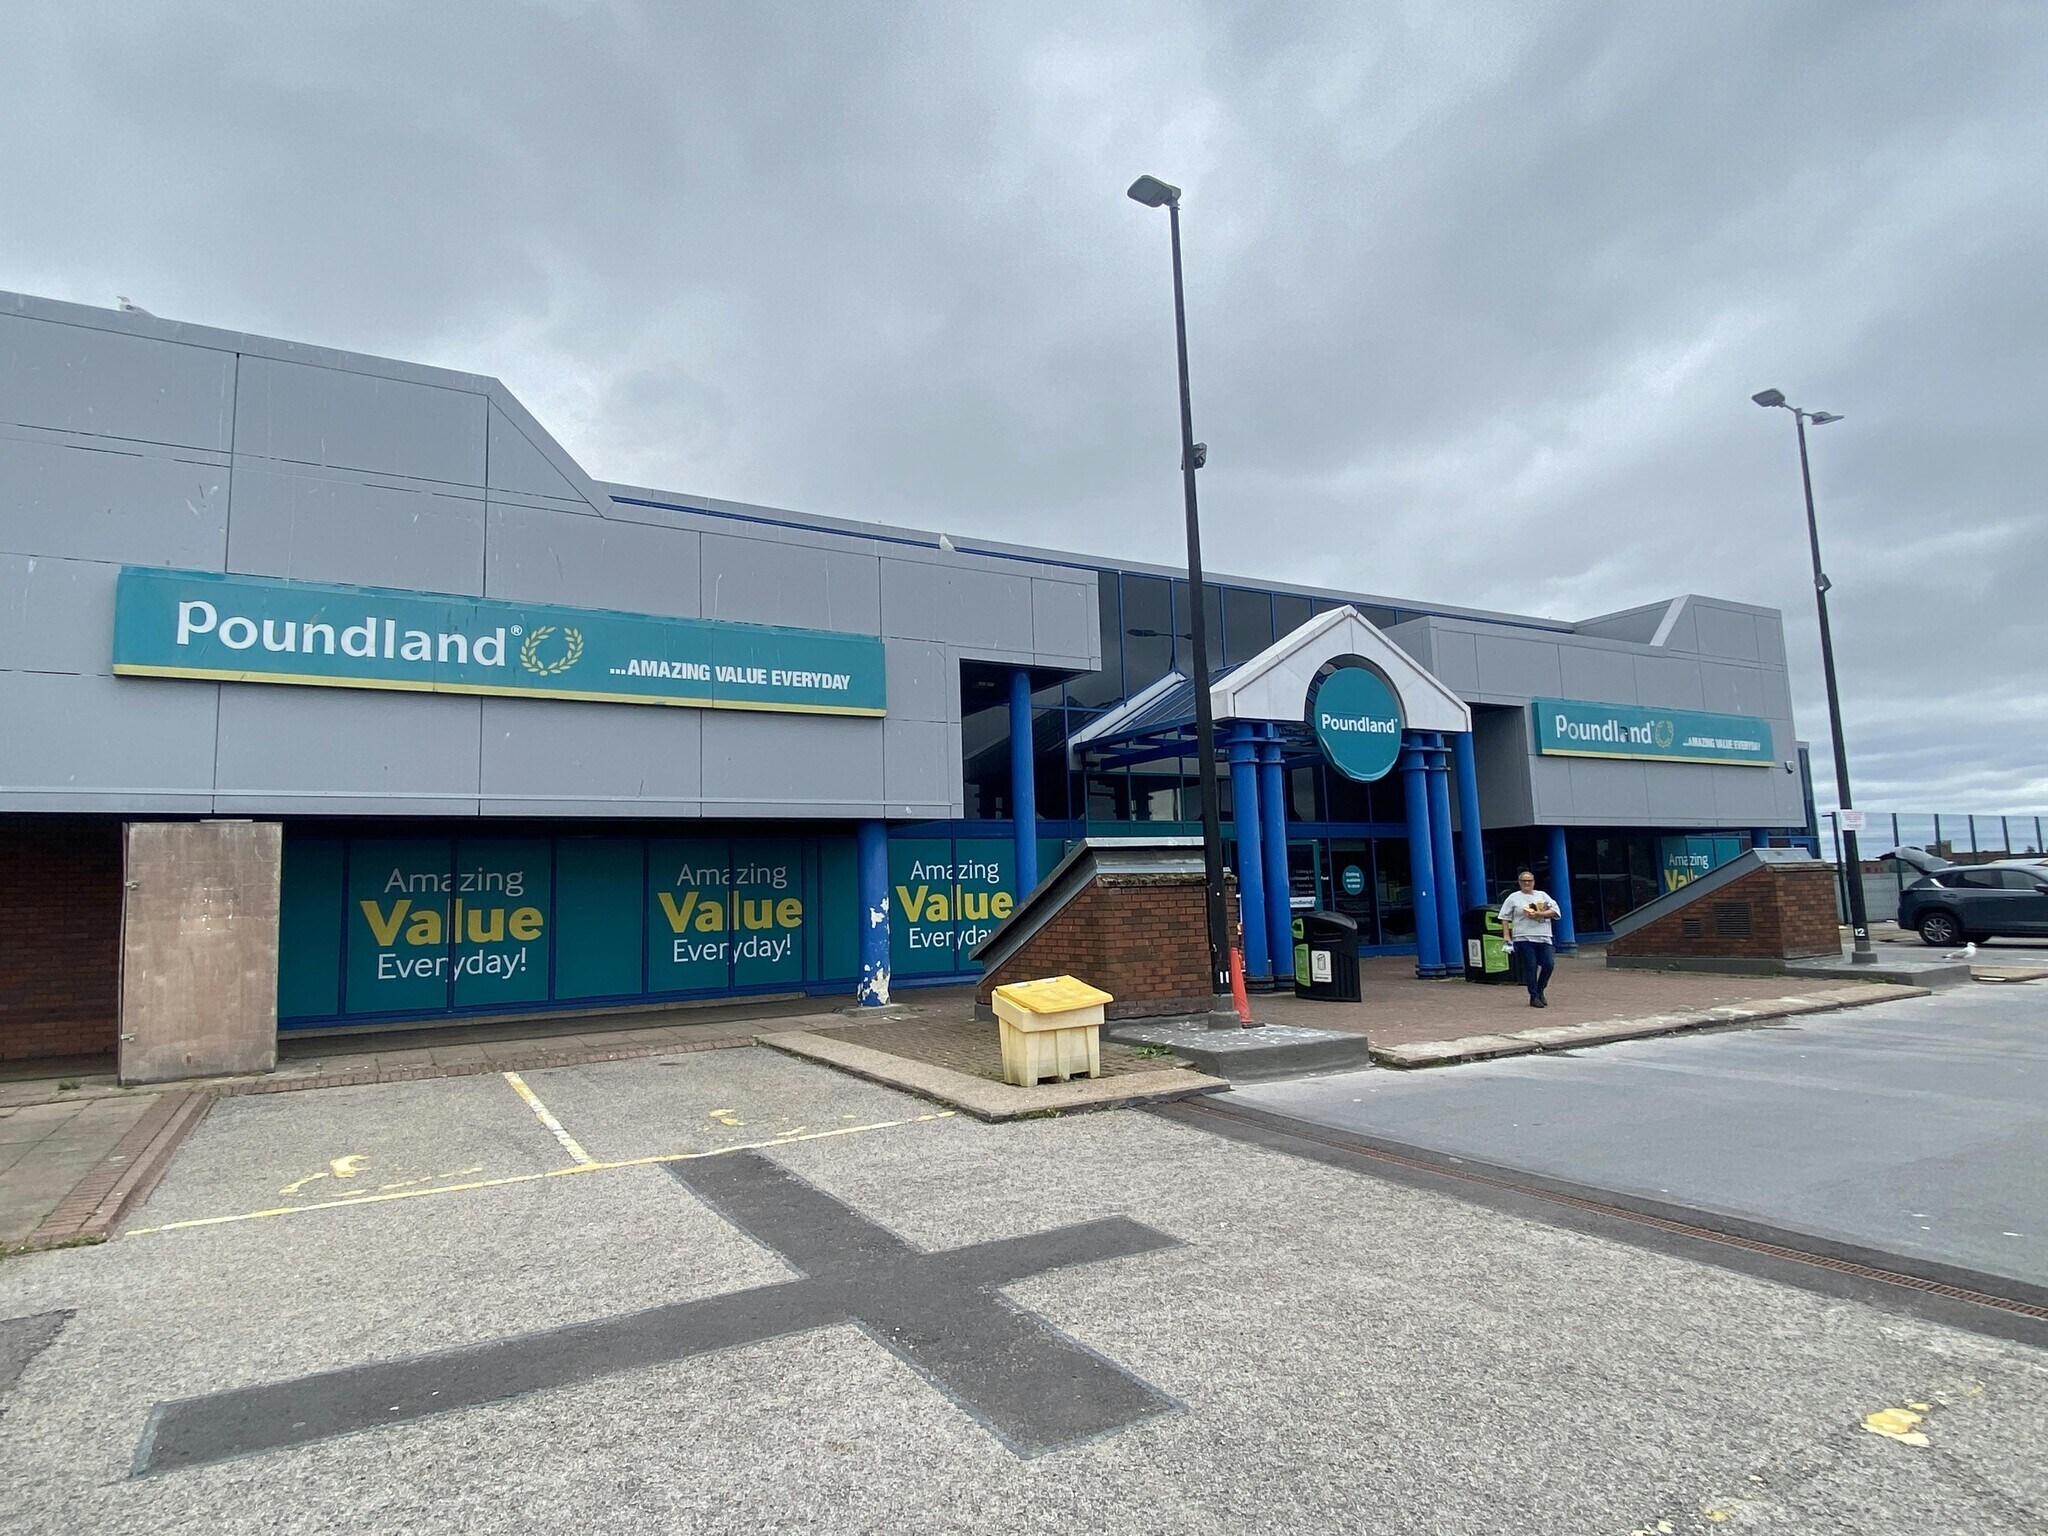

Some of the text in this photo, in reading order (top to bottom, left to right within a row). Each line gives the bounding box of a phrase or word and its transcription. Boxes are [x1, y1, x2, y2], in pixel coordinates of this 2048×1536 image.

[715, 665, 767, 685] VALUE
[771, 669, 851, 690] EVERYDAY
[910, 859, 1000, 884] Amazing
[1668, 852, 1710, 870] Amazing
[384, 866, 525, 897] Amazing
[676, 862, 788, 889] Amazing
[1663, 868, 1699, 892] Val
[657, 890, 803, 934] Value
[895, 884, 1014, 923] Value
[360, 898, 544, 947] Value
[1854, 927, 1866, 937] 12
[673, 933, 792, 965] Everyday!
[909, 925, 992, 951] Everyda
[378, 947, 527, 983] Everyday!
